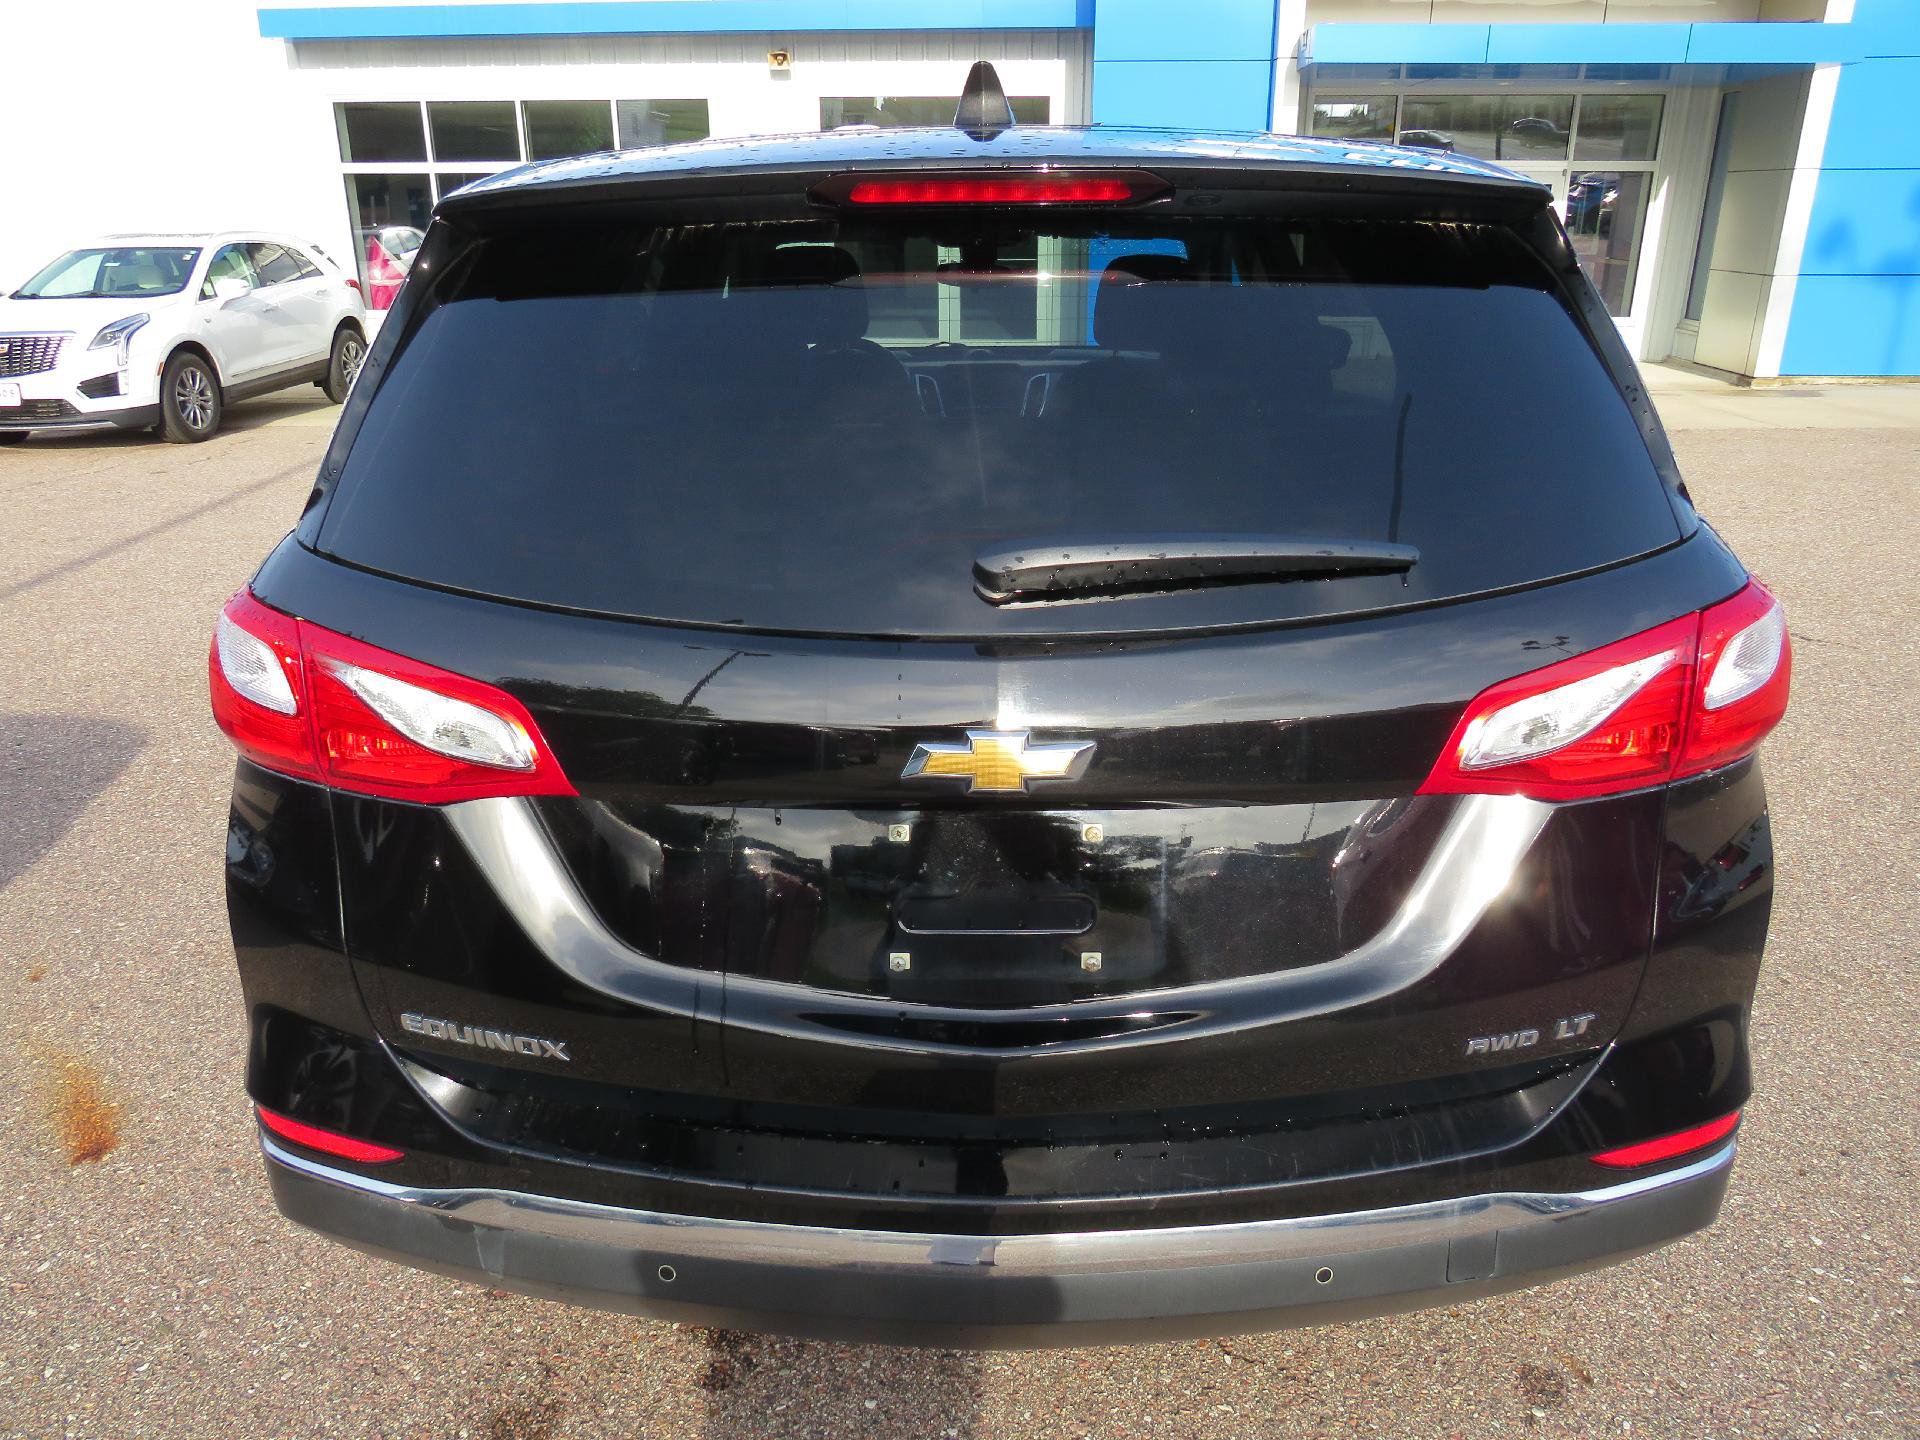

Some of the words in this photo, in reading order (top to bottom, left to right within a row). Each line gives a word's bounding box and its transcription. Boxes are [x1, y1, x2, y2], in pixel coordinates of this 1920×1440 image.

[400, 1012, 570, 1061] EQUINOX
[1466, 1028, 1540, 1056] AWD
[1555, 1013, 1598, 1040] LT
